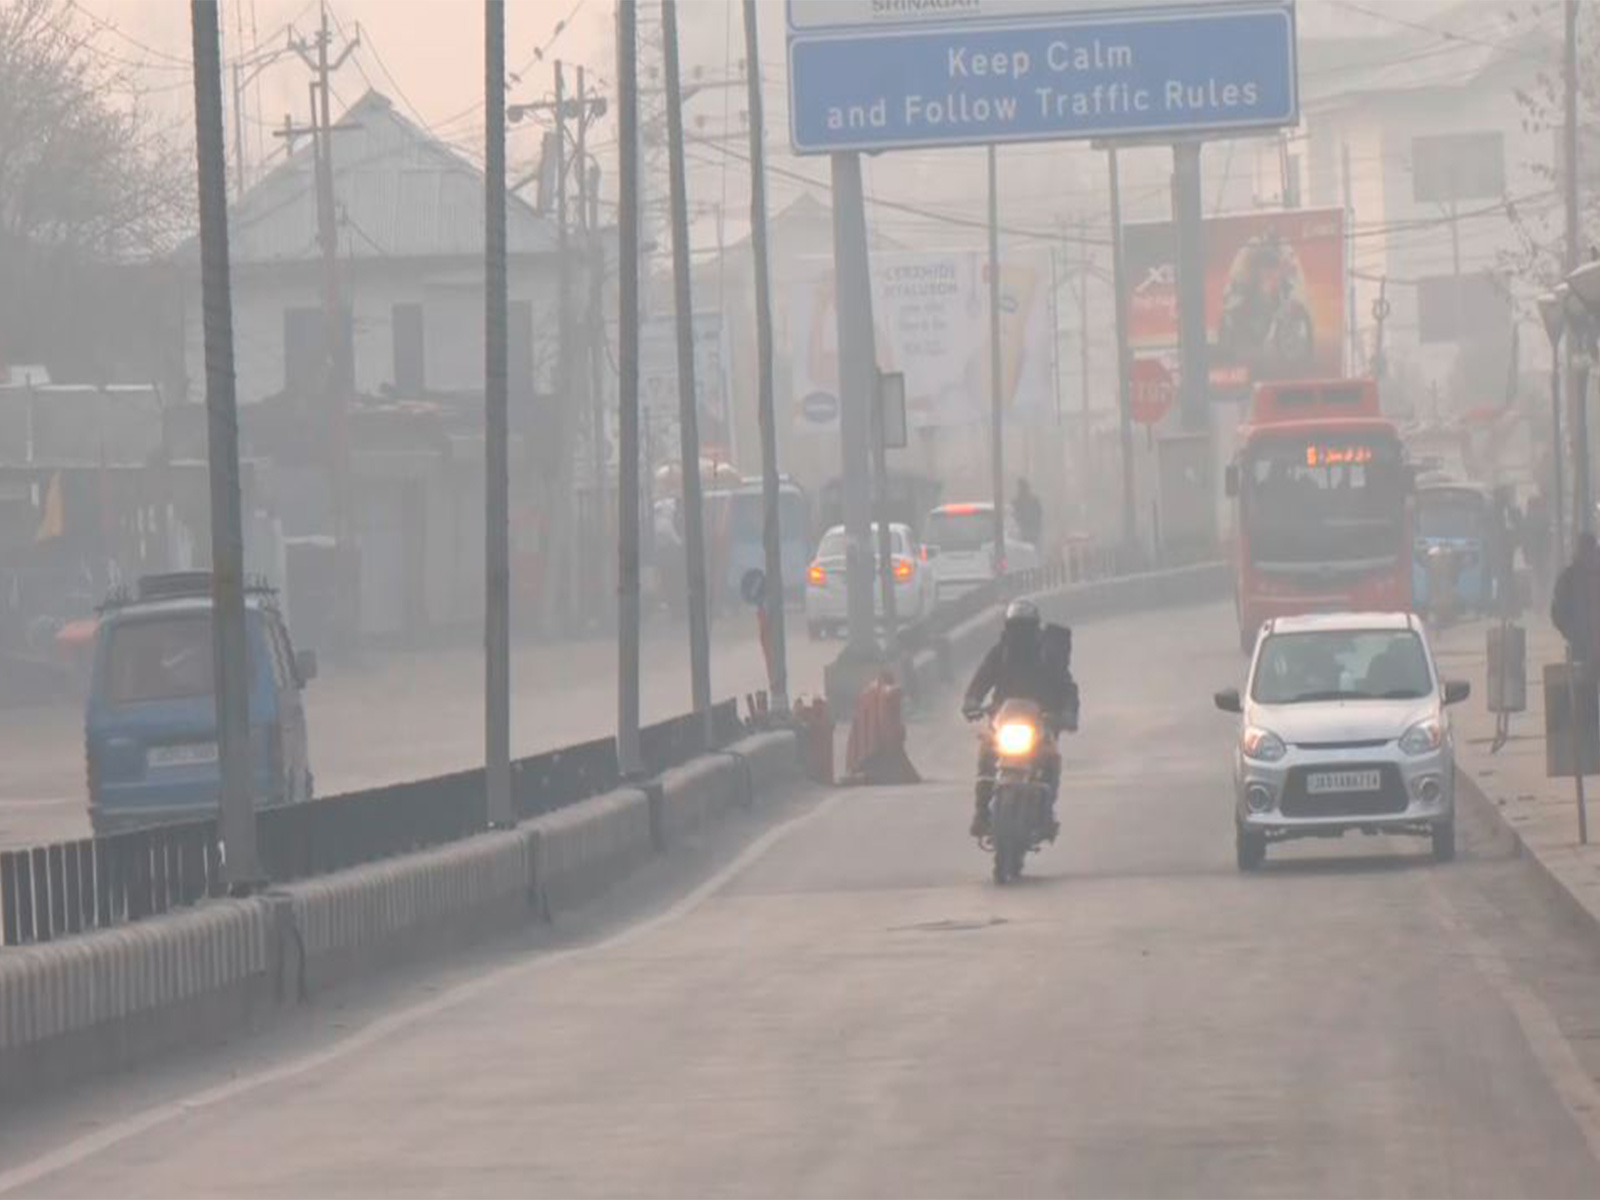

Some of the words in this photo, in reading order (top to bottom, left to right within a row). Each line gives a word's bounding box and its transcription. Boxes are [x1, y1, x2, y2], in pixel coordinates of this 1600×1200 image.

[872, 0, 980, 12] SRINA
[948, 47, 1030, 79] Keep
[1047, 40, 1133, 71] Calm
[827, 97, 887, 129] and
[905, 93, 1017, 125] Follow
[1036, 83, 1150, 118] Traffic
[1165, 78, 1258, 110] Rules
